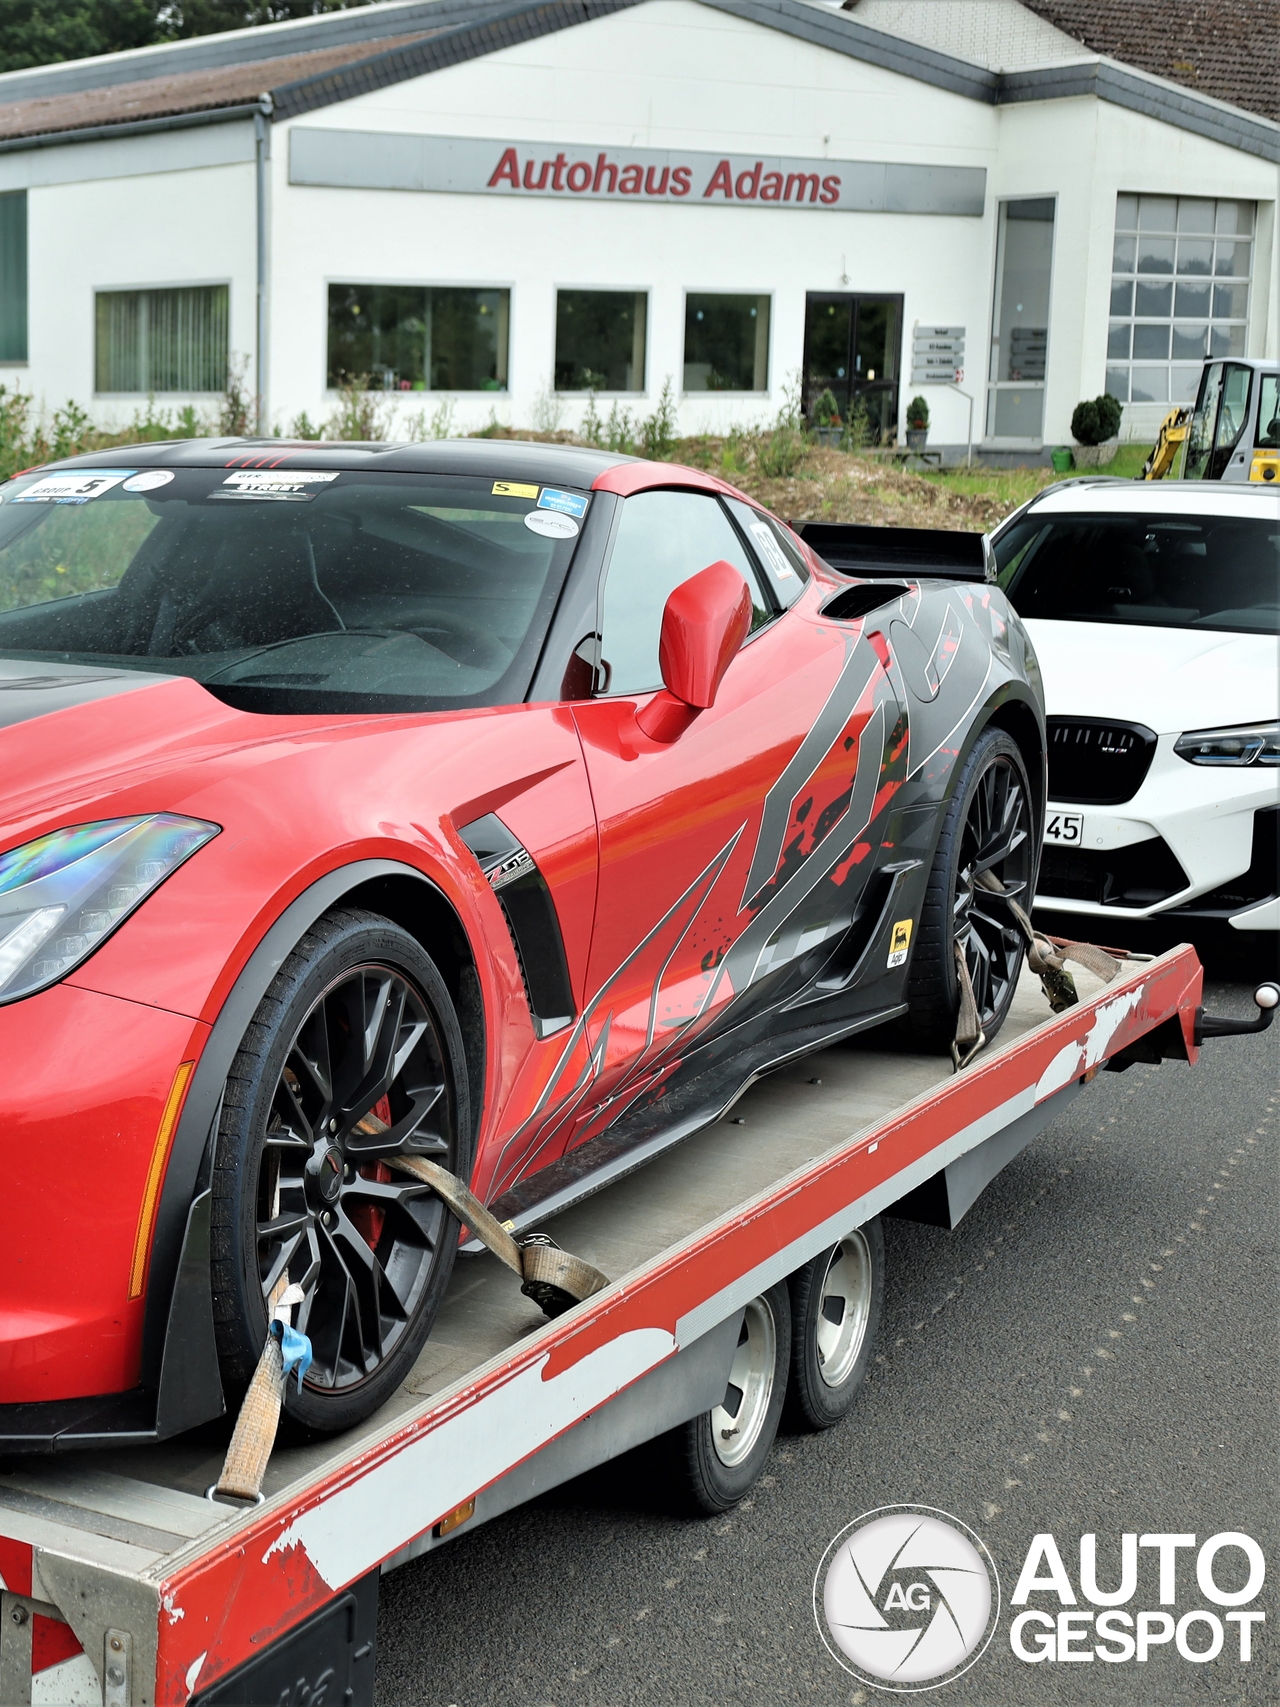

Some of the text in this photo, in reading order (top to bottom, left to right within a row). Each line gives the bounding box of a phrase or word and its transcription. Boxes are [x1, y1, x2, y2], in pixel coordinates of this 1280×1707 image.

[486, 147, 842, 205] Autohaus Adams
[32, 479, 107, 495] GROUP 5
[236, 483, 305, 492] STREET
[890, 953, 904, 966] Agip
